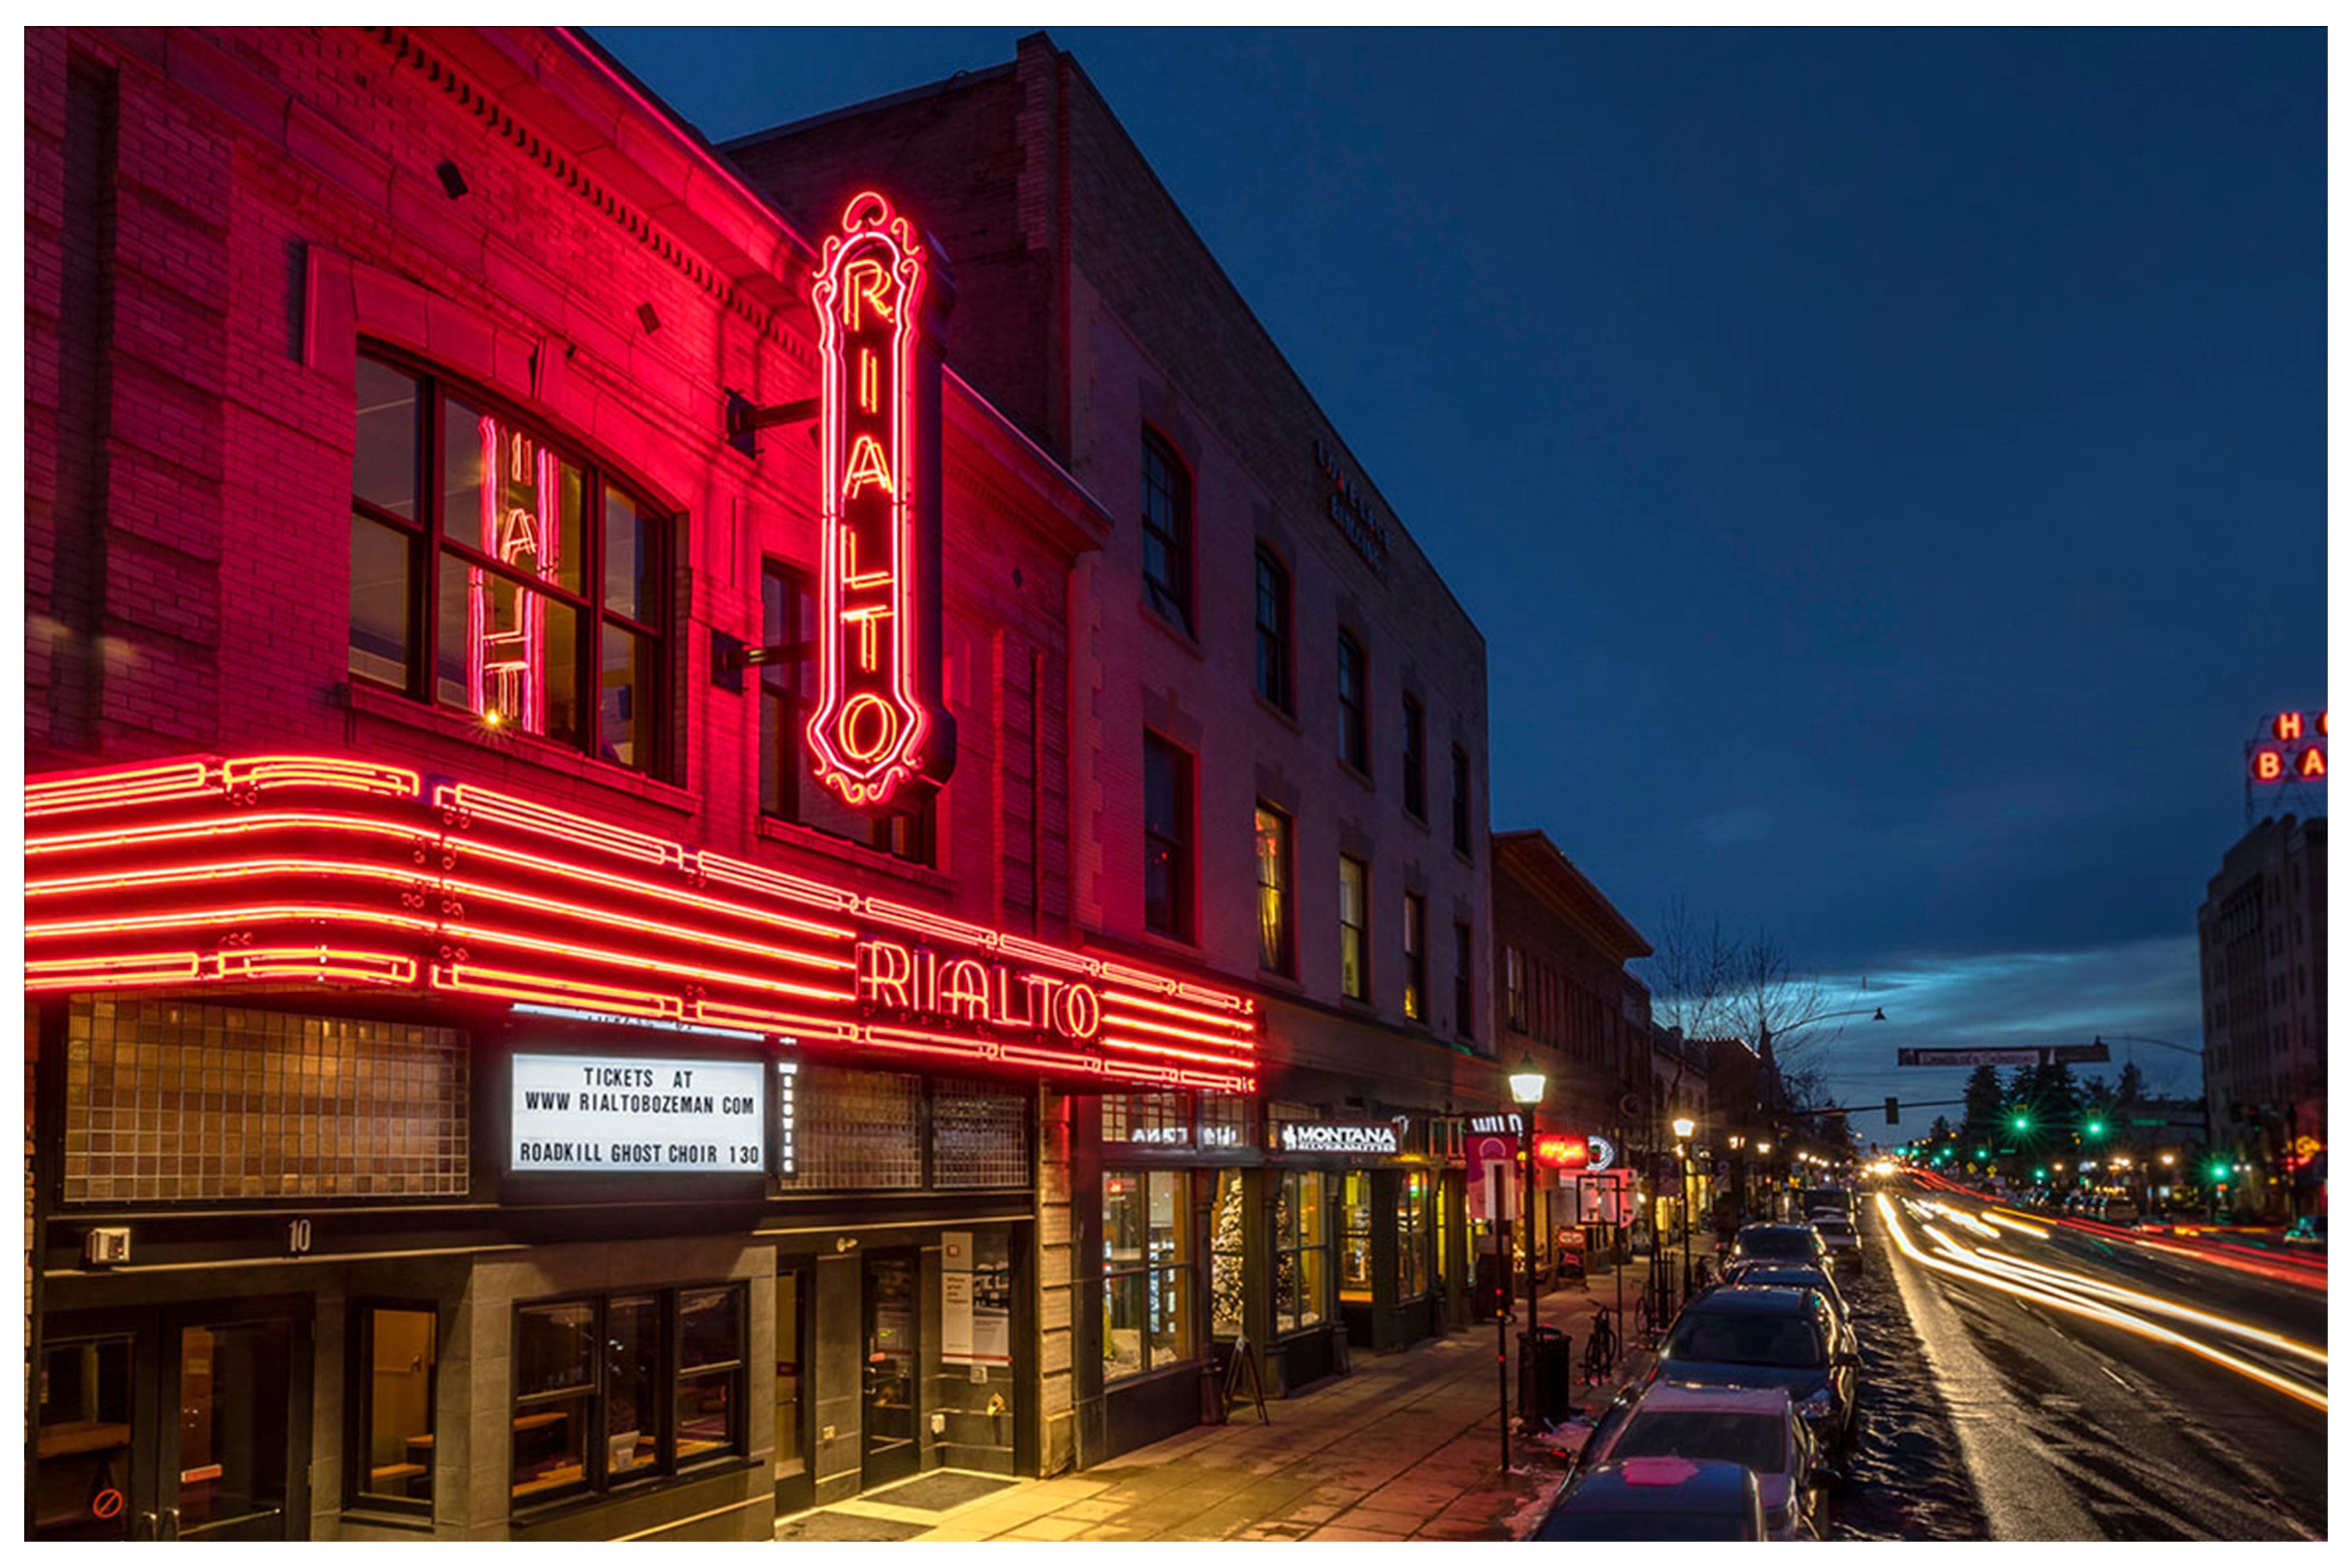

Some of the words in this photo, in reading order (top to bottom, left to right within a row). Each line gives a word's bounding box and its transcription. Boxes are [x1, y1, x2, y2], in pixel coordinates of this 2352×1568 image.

[839, 260, 897, 763] RIALTO
[2280, 711, 2327, 740] H
[855, 940, 1099, 1039] RIALTO
[584, 1067, 653, 1087] TICKETS
[673, 1071, 693, 1088] AT
[525, 1091, 571, 1111] WWW
[580, 1093, 713, 1114] RIALTOBOZEMAN
[723, 1097, 754, 1115] COM
[1298, 1127, 1396, 1144] MONTANA
[520, 1142, 602, 1162] ROADKILL
[611, 1144, 662, 1163] GHOST
[669, 1145, 717, 1164] CHOIR
[289, 1219, 311, 1251] 10
